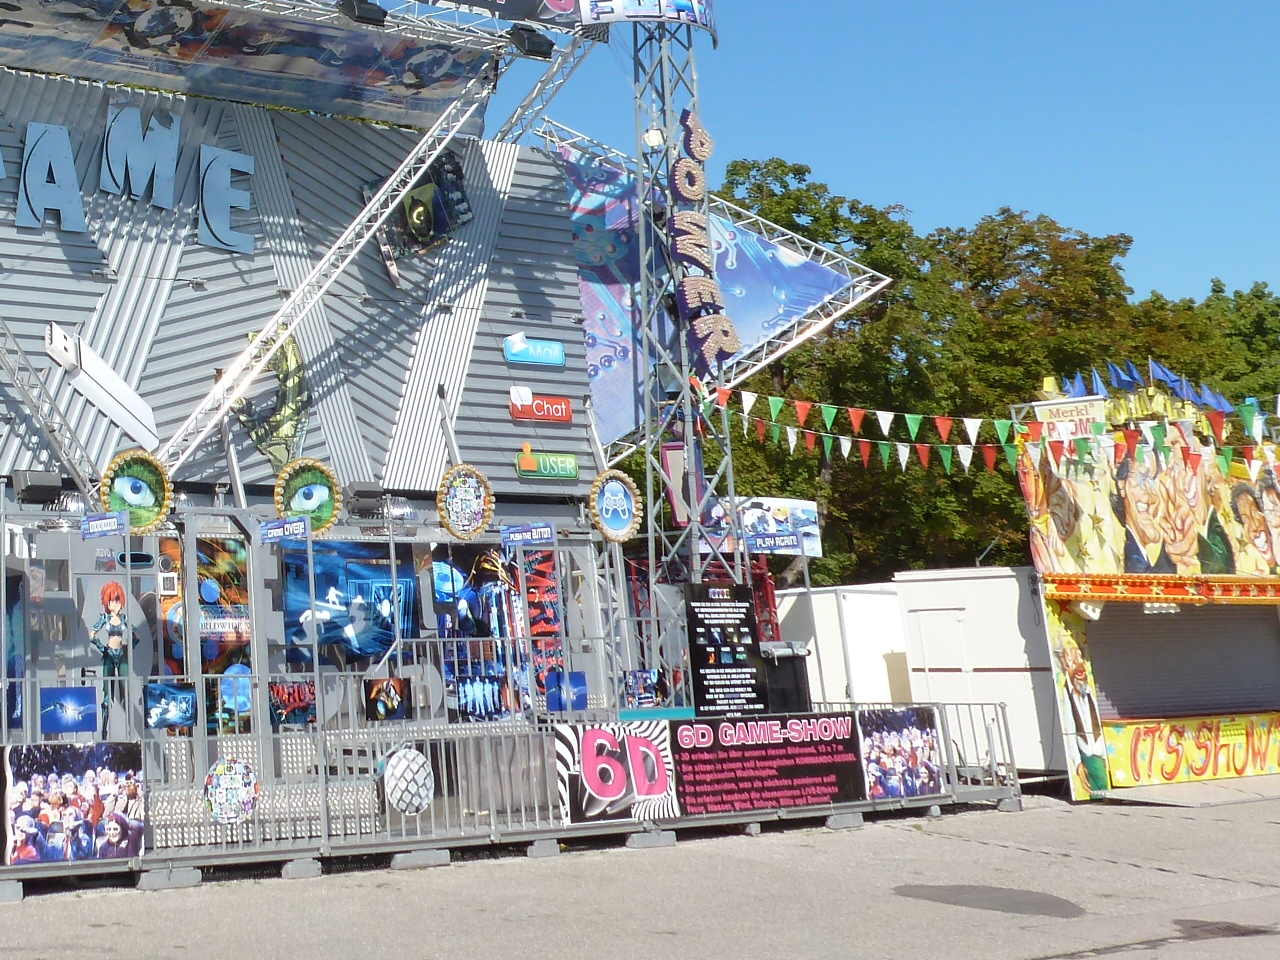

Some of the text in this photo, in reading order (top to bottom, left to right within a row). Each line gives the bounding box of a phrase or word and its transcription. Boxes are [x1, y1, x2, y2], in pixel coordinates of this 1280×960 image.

[672, 109, 740, 374] POWER
[532, 399, 567, 417] Chat
[540, 457, 575, 474] USER
[756, 535, 798, 548] PLAY AGAIN!
[677, 718, 852, 749] 6D GAME-SHOW
[580, 727, 670, 801] 6D
[1130, 722, 1184, 782] IT'S
[1190, 720, 1272, 777] SHOW
